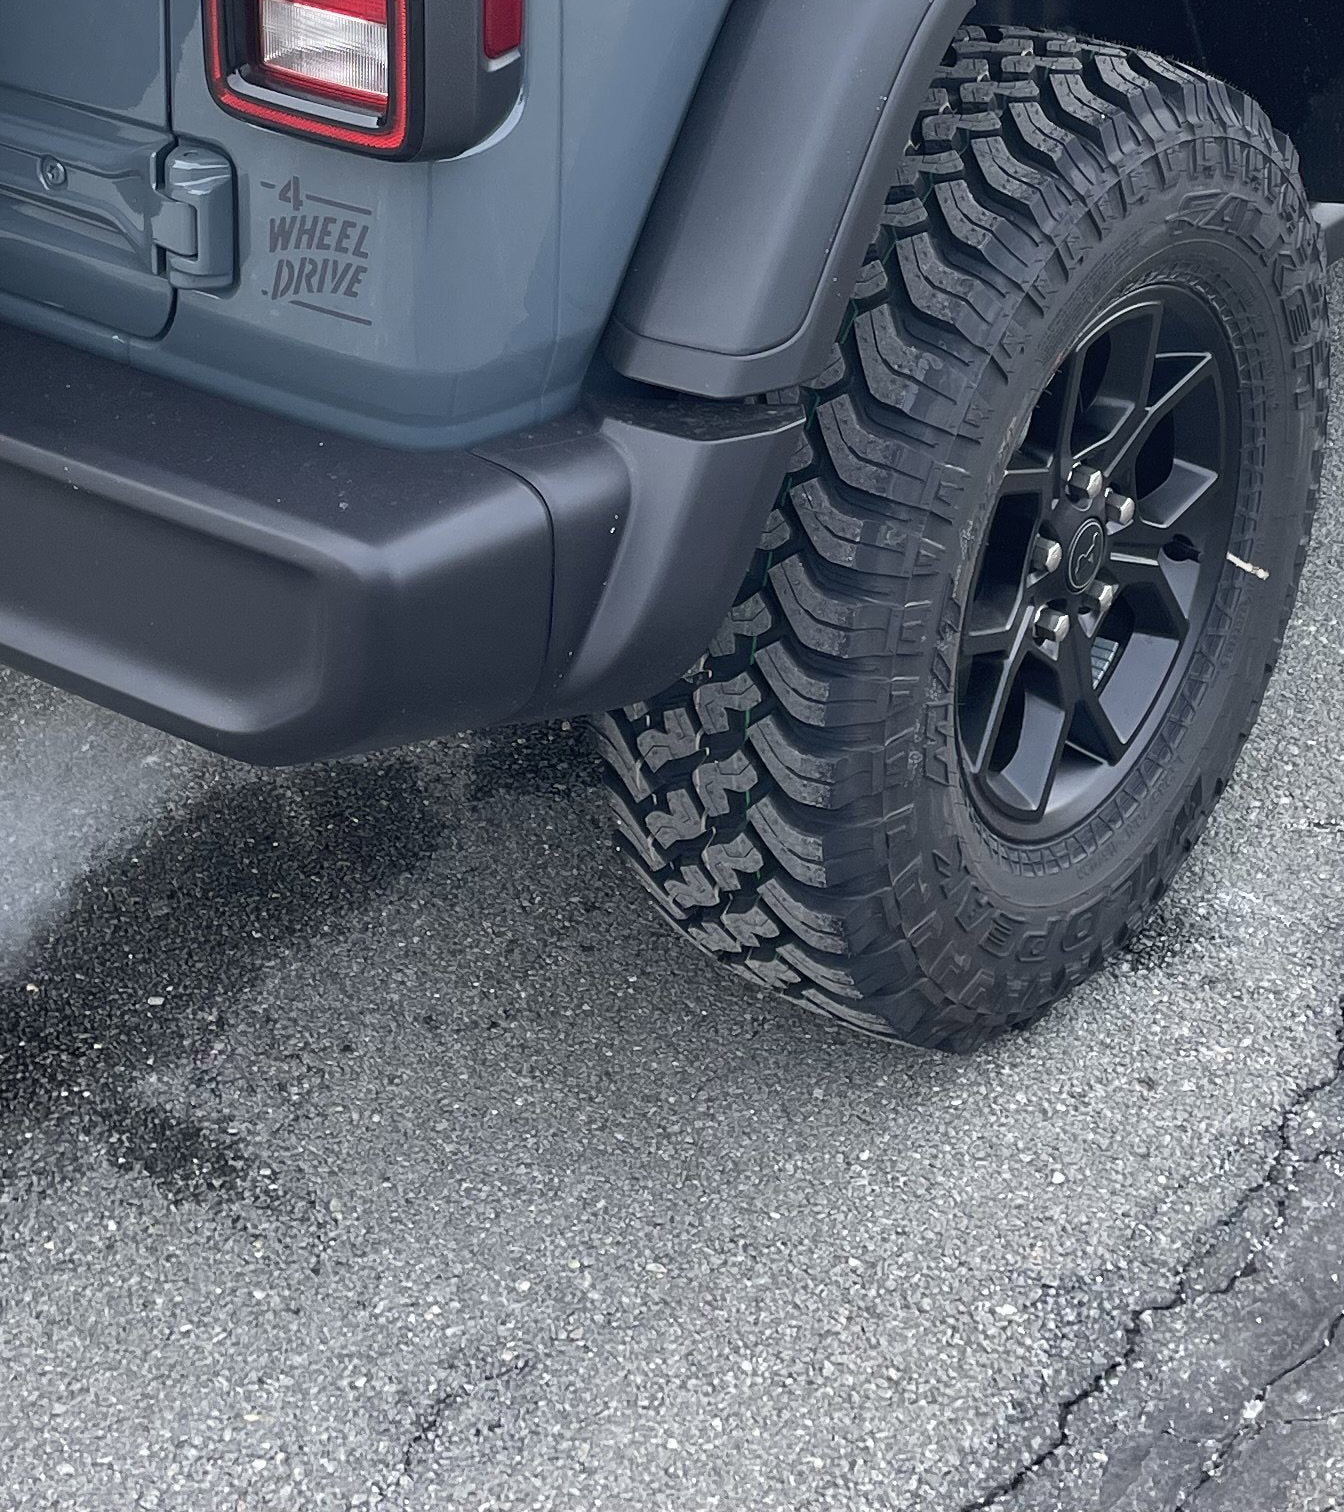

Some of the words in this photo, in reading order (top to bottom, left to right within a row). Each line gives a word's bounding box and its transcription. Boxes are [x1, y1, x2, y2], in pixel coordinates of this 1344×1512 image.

[278, 175, 303, 211] 4
[269, 215, 370, 260] WHEEL
[271, 257, 369, 300] DRIVE
